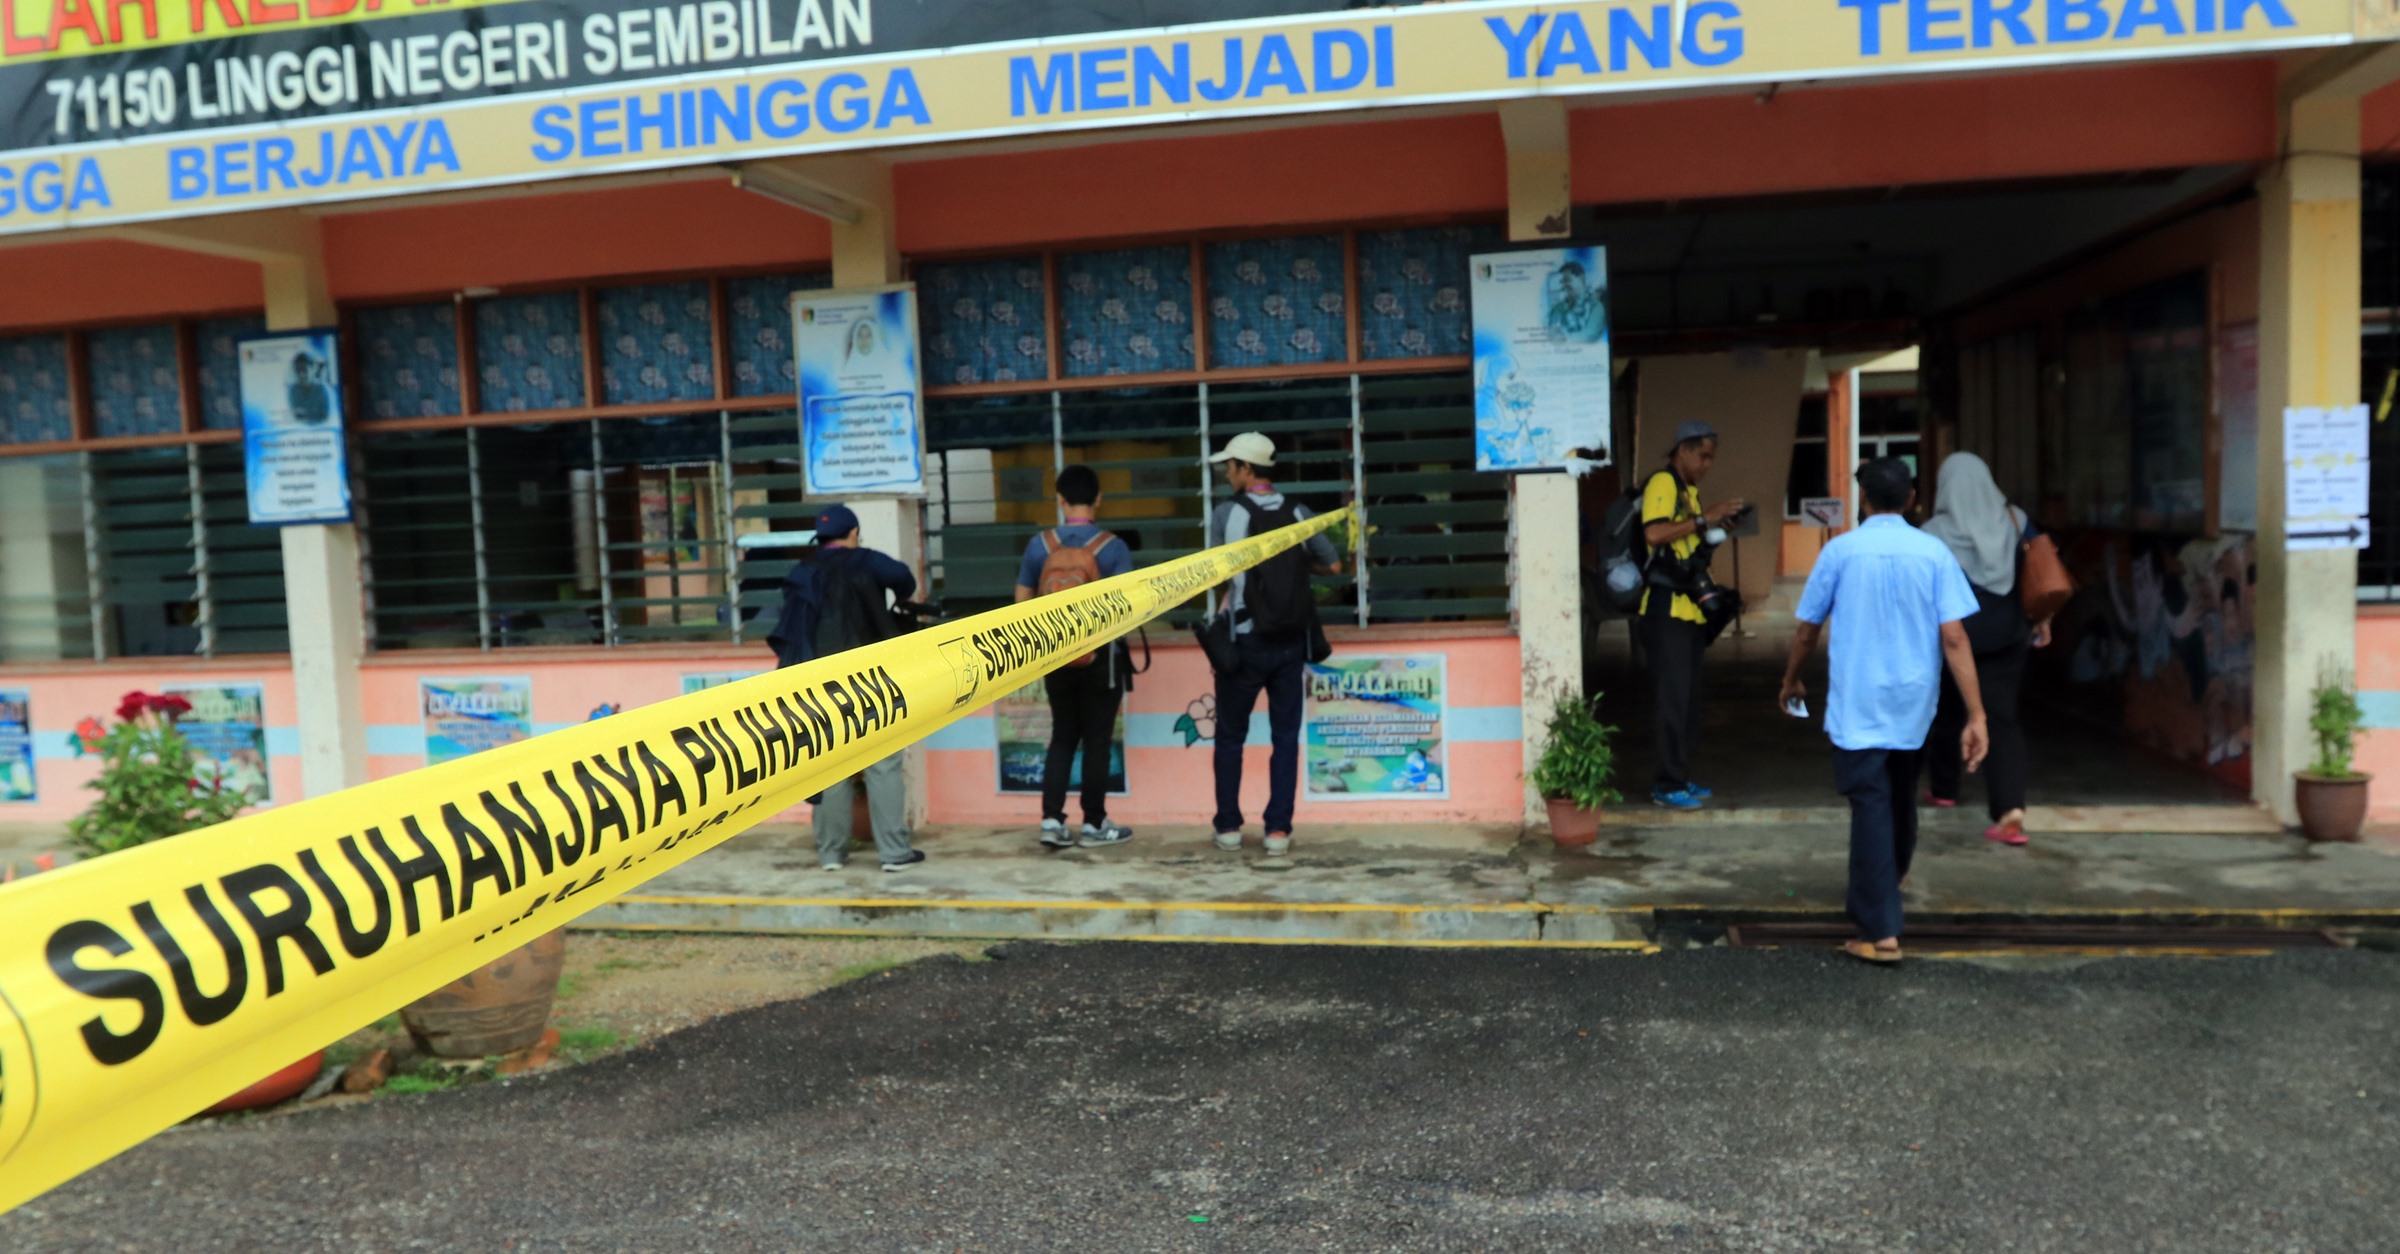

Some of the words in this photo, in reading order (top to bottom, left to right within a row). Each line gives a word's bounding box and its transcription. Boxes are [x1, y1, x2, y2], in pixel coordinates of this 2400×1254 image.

[46, 66, 176, 136] 71150
[187, 44, 358, 120] LINGGI
[369, 18, 569, 98] NEGERI
[582, 0, 873, 76] SEMBILAN
[168, 118, 462, 201] BERJAYA
[530, 67, 932, 162] SEHINGGA
[1009, 25, 1396, 118] MENJADI
[1484, 0, 1745, 79] YANG
[971, 607, 1076, 682] SURUHANJAYA
[1066, 594, 1113, 642] PILIHAN
[1104, 588, 1133, 624] RAYA
[45, 741, 687, 1066] SURUHANJAYA
[670, 687, 836, 808] PILIHAN
[822, 665, 908, 745] RAYA
